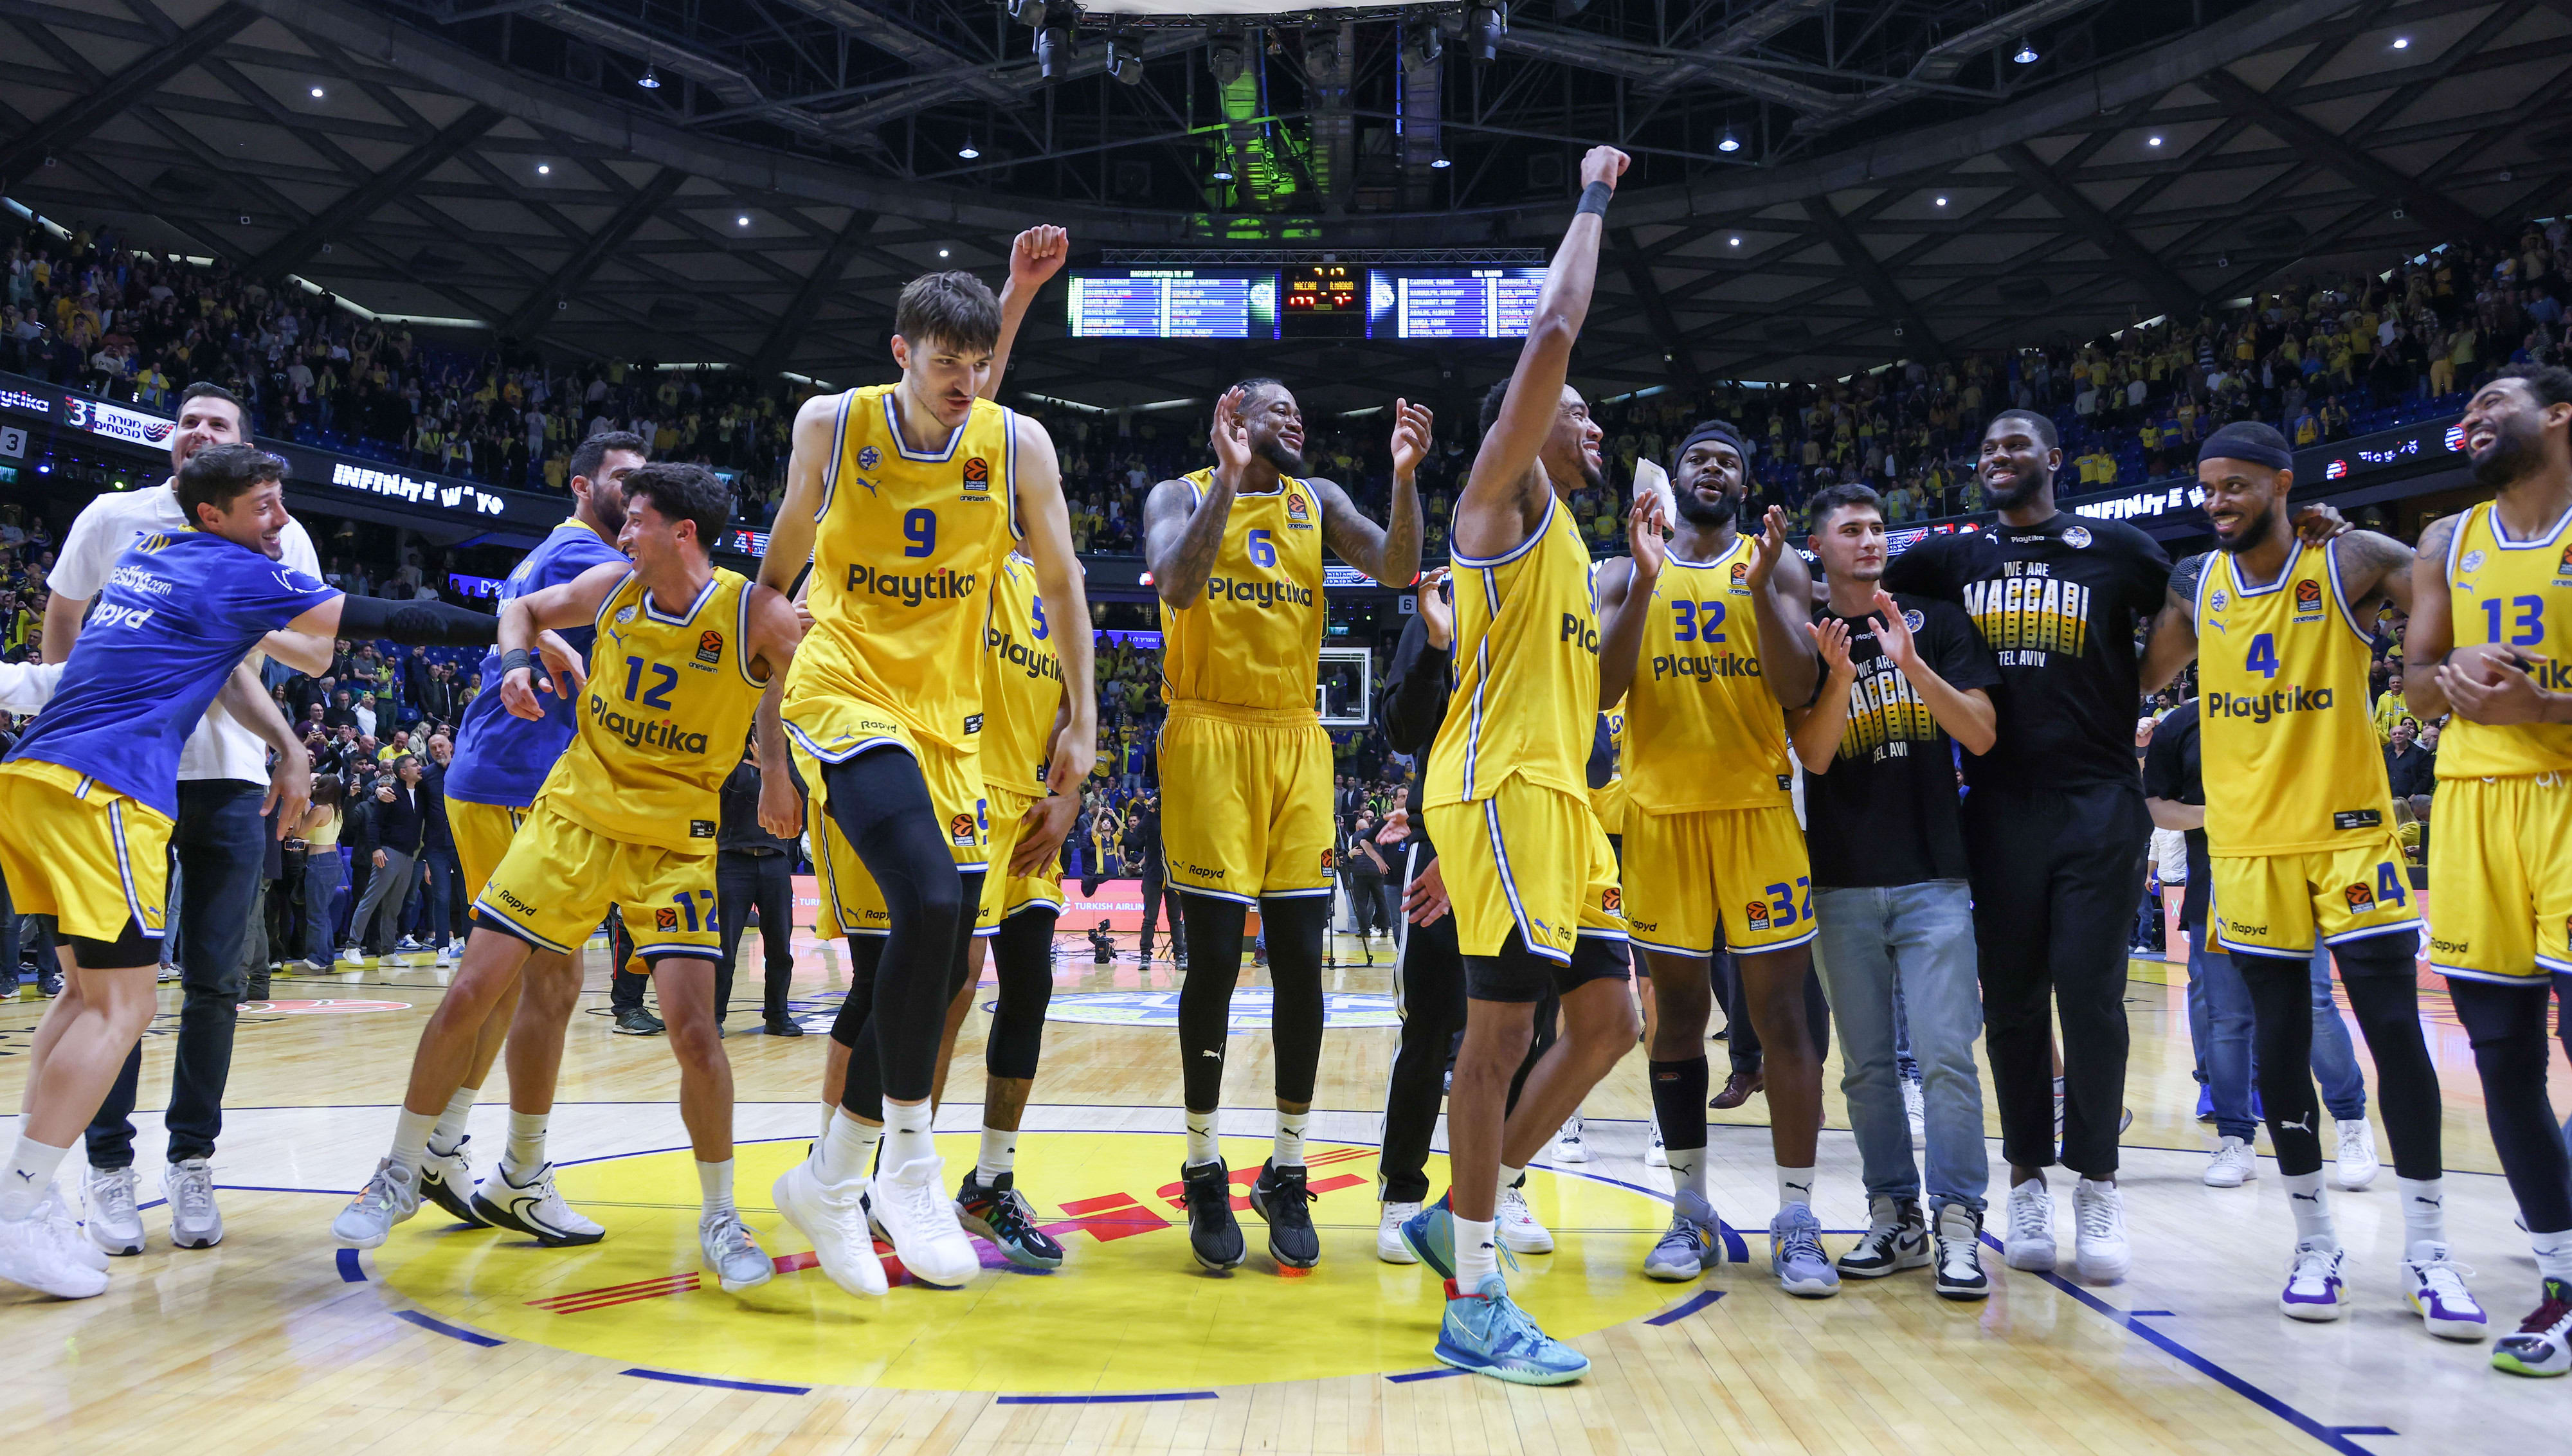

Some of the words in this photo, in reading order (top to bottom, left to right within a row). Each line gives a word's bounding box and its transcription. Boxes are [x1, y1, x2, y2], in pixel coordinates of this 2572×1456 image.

[0, 390, 50, 413] ytika
[69, 399, 87, 426] 3
[6, 433, 19, 451] 3
[332, 463, 438, 503] INFINITE
[903, 508, 937, 558] 9
[1248, 528, 1276, 568] 6
[2011, 535, 2045, 544] Playtika
[2004, 561, 2022, 577] WE
[2025, 561, 2051, 577] ARE
[846, 563, 976, 607] Playtika
[1208, 576, 1313, 609] Playtika
[1031, 595, 1049, 640] 5
[1403, 598, 1413, 610] 6
[1962, 577, 2090, 630] MACCABI
[1671, 599, 1726, 643] 32
[2293, 614, 2326, 624] oneteam
[2481, 594, 2545, 647] 13
[688, 661, 718, 674] oneteam
[1653, 649, 1761, 683] Playtika
[1856, 658, 1874, 679] WE
[1998, 650, 2016, 667] TEL
[2018, 650, 2047, 667] AVIV
[2246, 633, 2279, 679] 4
[624, 655, 678, 712] 12
[2208, 683, 2333, 724] Playtika
[591, 694, 709, 755] Playtika
[860, 720, 898, 734] Rapyd
[1873, 743, 1887, 764] TEL
[1188, 864, 1226, 879] Rapyd
[2377, 861, 2406, 908] 4
[498, 889, 538, 917] Rapyd
[673, 889, 720, 933] 12
[865, 908, 891, 921] Rapy
[1074, 901, 1113, 911] TURKISH
[1115, 902, 1145, 911] AIRLIN
[1765, 876, 1813, 928] 32
[2231, 922, 2268, 936] Rapyd
